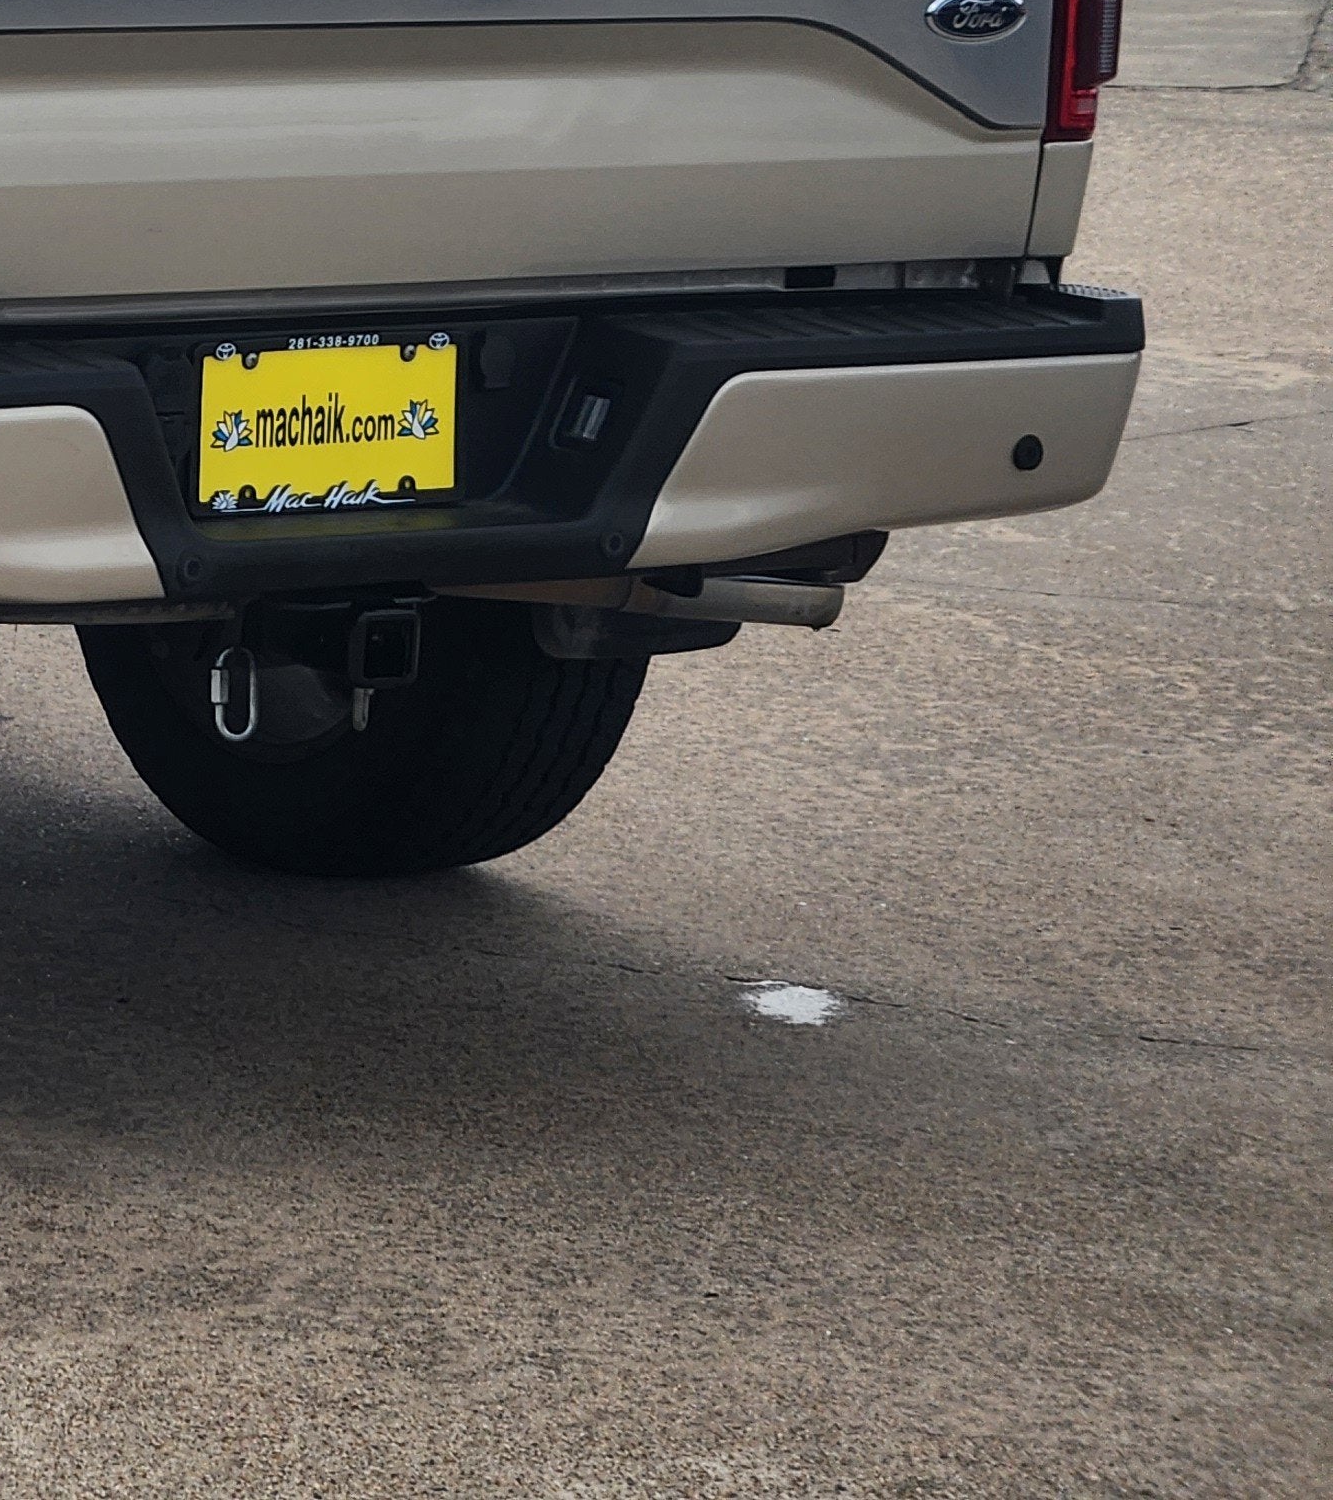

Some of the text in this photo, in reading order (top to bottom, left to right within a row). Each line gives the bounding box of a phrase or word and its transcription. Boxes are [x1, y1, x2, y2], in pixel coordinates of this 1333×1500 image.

[953, 0, 1008, 29] Ford
[288, 333, 380, 350] 281-338-9700
[255, 392, 395, 448] machaik.com
[264, 479, 393, 513] Mac Haik
